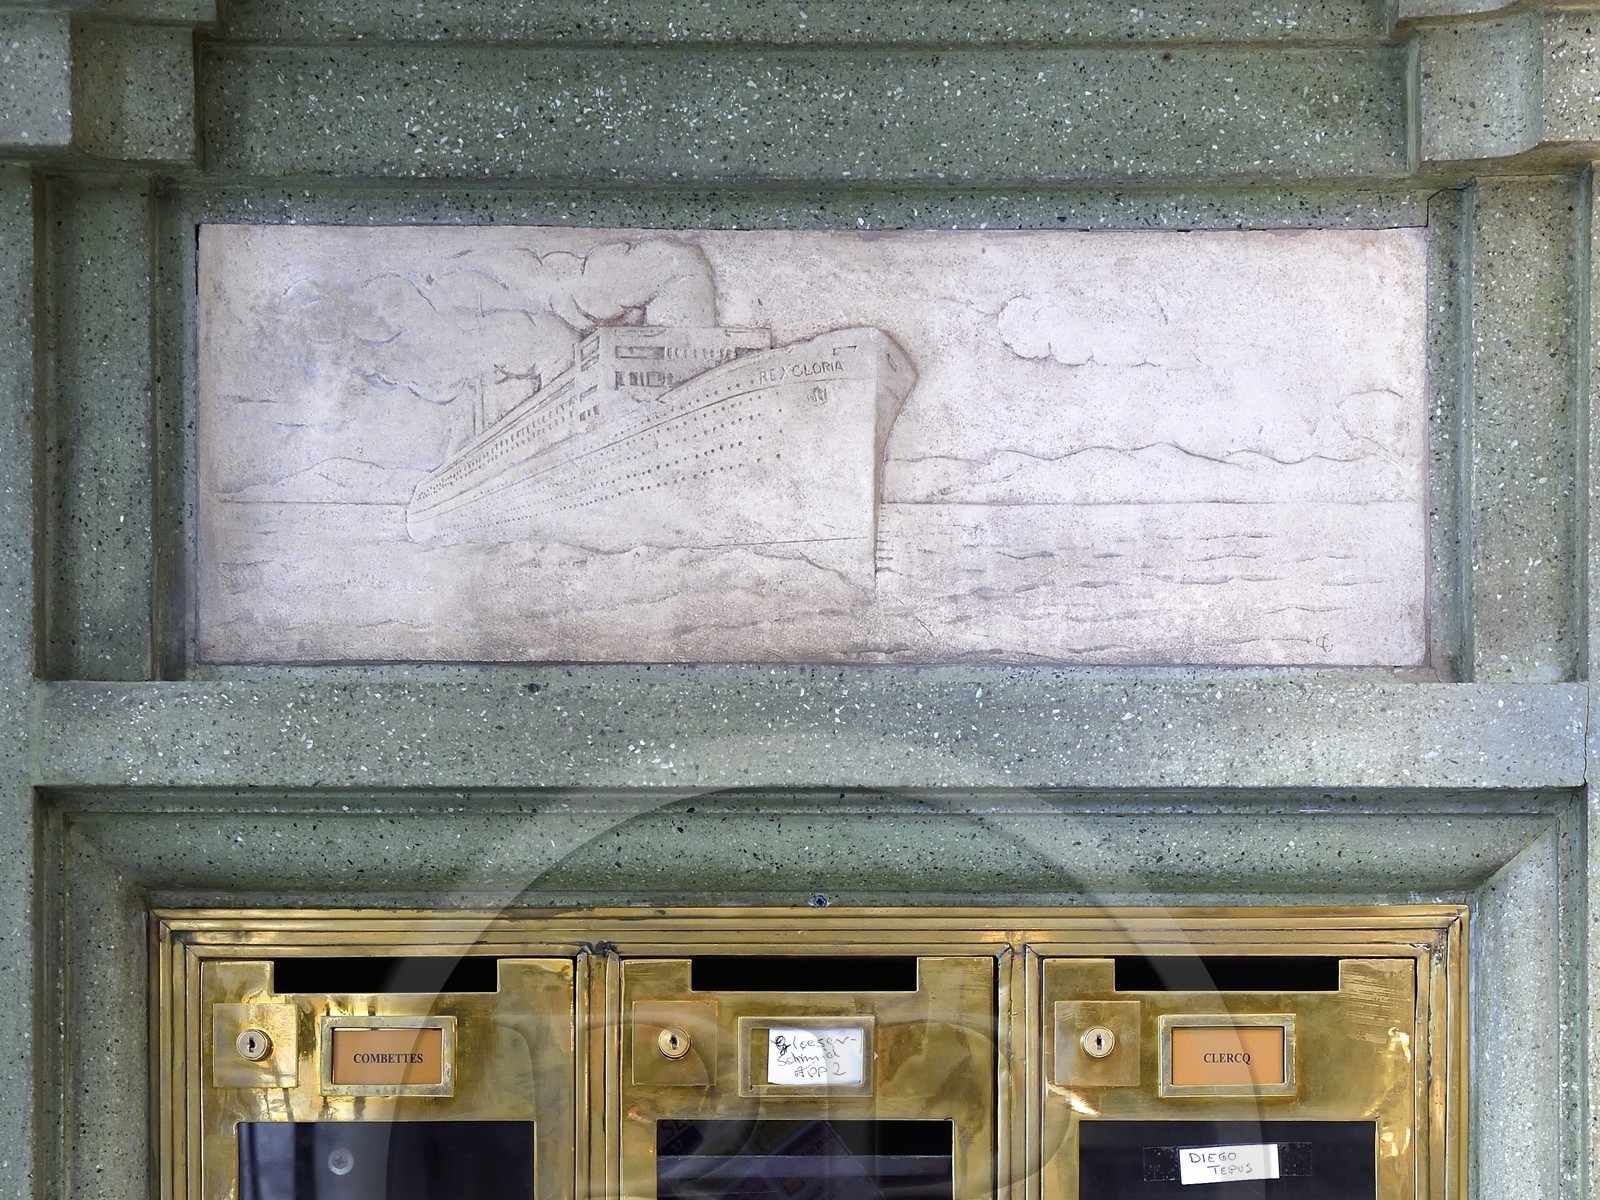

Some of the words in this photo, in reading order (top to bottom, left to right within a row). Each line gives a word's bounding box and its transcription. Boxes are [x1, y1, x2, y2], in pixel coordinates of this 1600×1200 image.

[353, 1053, 424, 1064] COMBETTES
[1203, 1053, 1252, 1065] CLERCQ
[832, 1062, 847, 1076] 2
[1188, 1152, 1237, 1163] DIEGO
